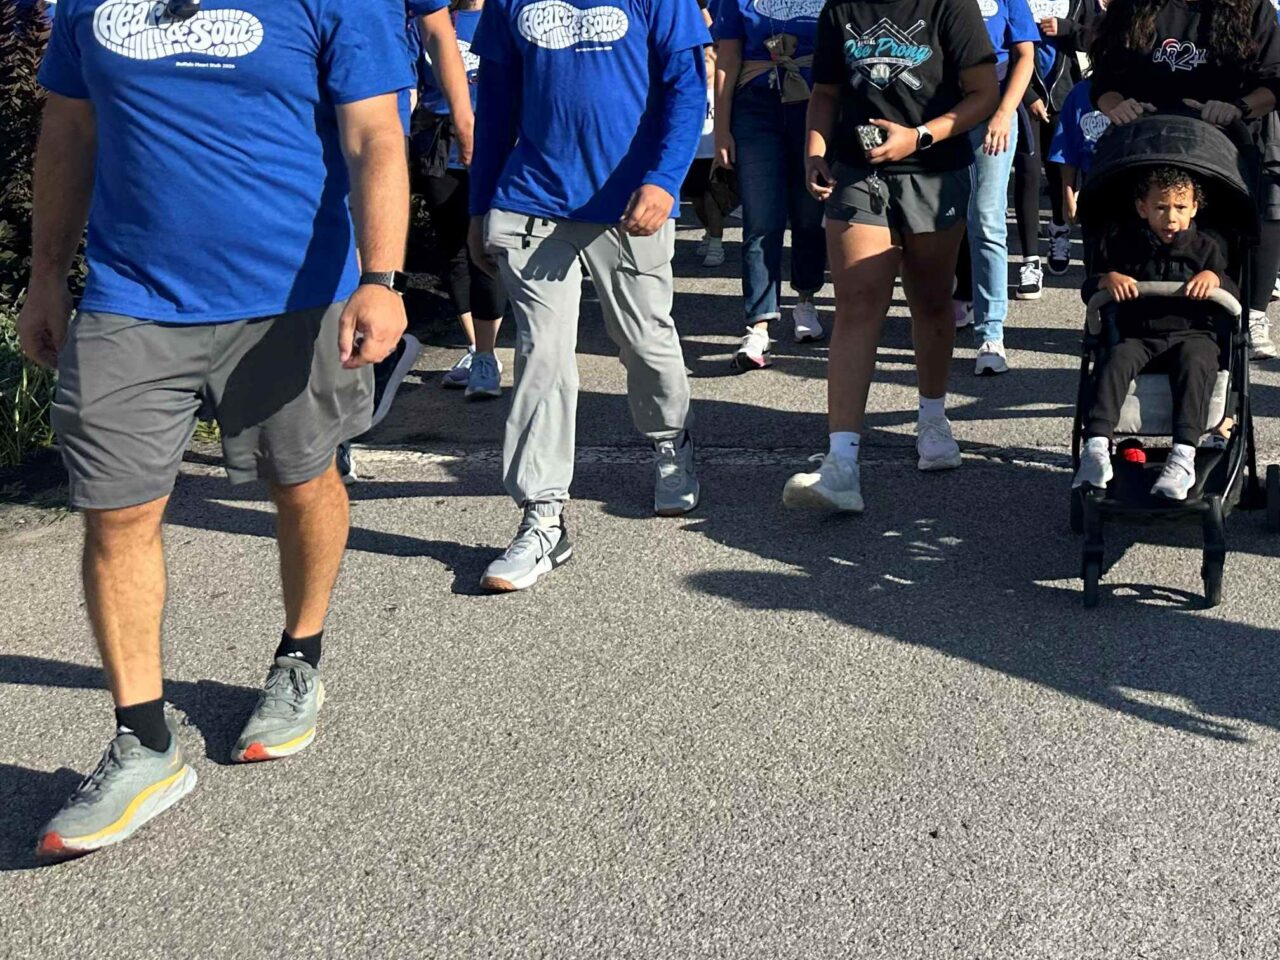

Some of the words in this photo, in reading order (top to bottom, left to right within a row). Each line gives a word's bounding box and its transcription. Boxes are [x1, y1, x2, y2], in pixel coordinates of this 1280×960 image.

[521, 2, 572, 40] Heart
[568, 13, 582, 36] &
[581, 13, 622, 38] Soul
[166, 22, 190, 44] &
[187, 20, 254, 50] Soul
[1082, 114, 1110, 139] Hear
